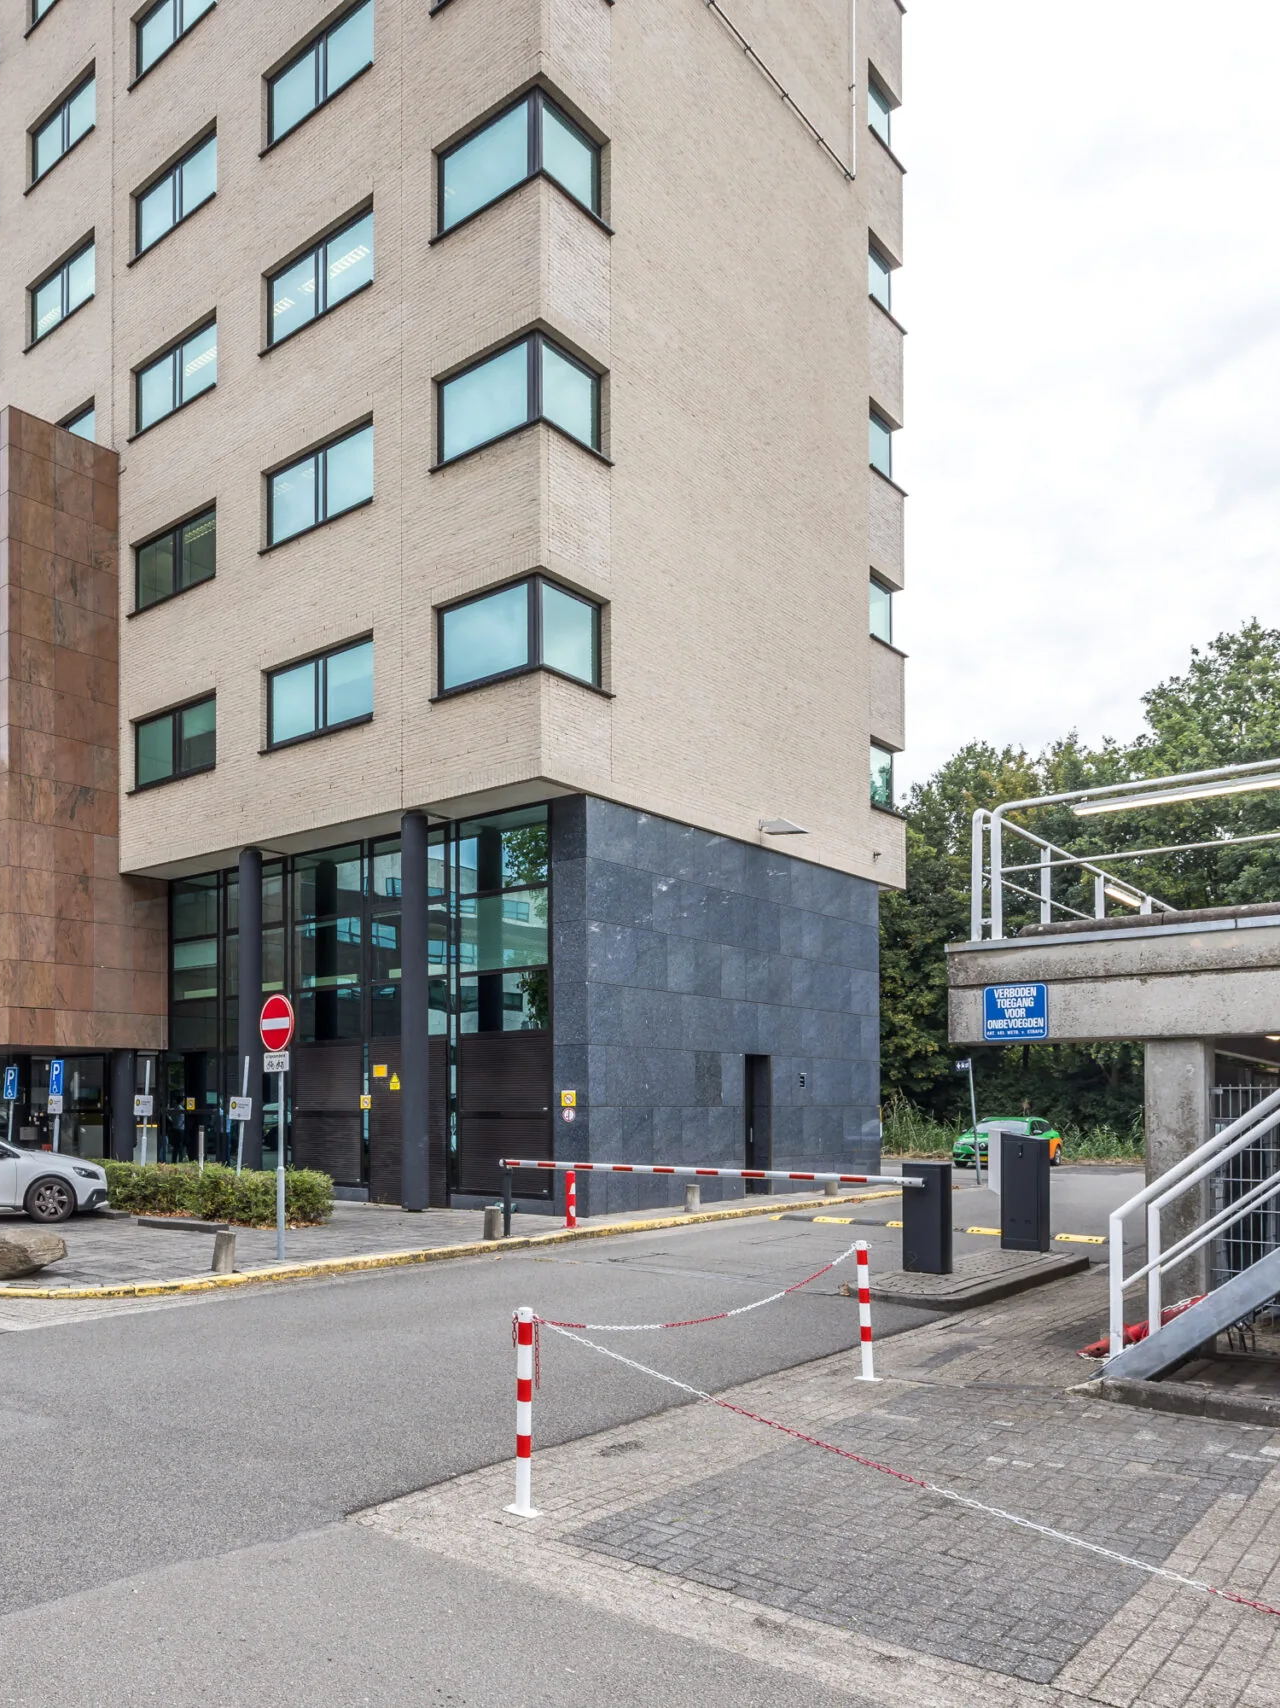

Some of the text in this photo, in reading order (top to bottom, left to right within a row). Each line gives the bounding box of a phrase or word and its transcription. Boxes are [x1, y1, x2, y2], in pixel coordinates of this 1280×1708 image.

[993, 987, 1037, 998] VERBODEN
[996, 997, 1034, 1009] TOEGANG
[1004, 1008, 1026, 1019] VOOR
[987, 1017, 1044, 1030] ONBEVOEGDEN
[7, 1069, 15, 1086] P
[52, 1063, 60, 1081] P
